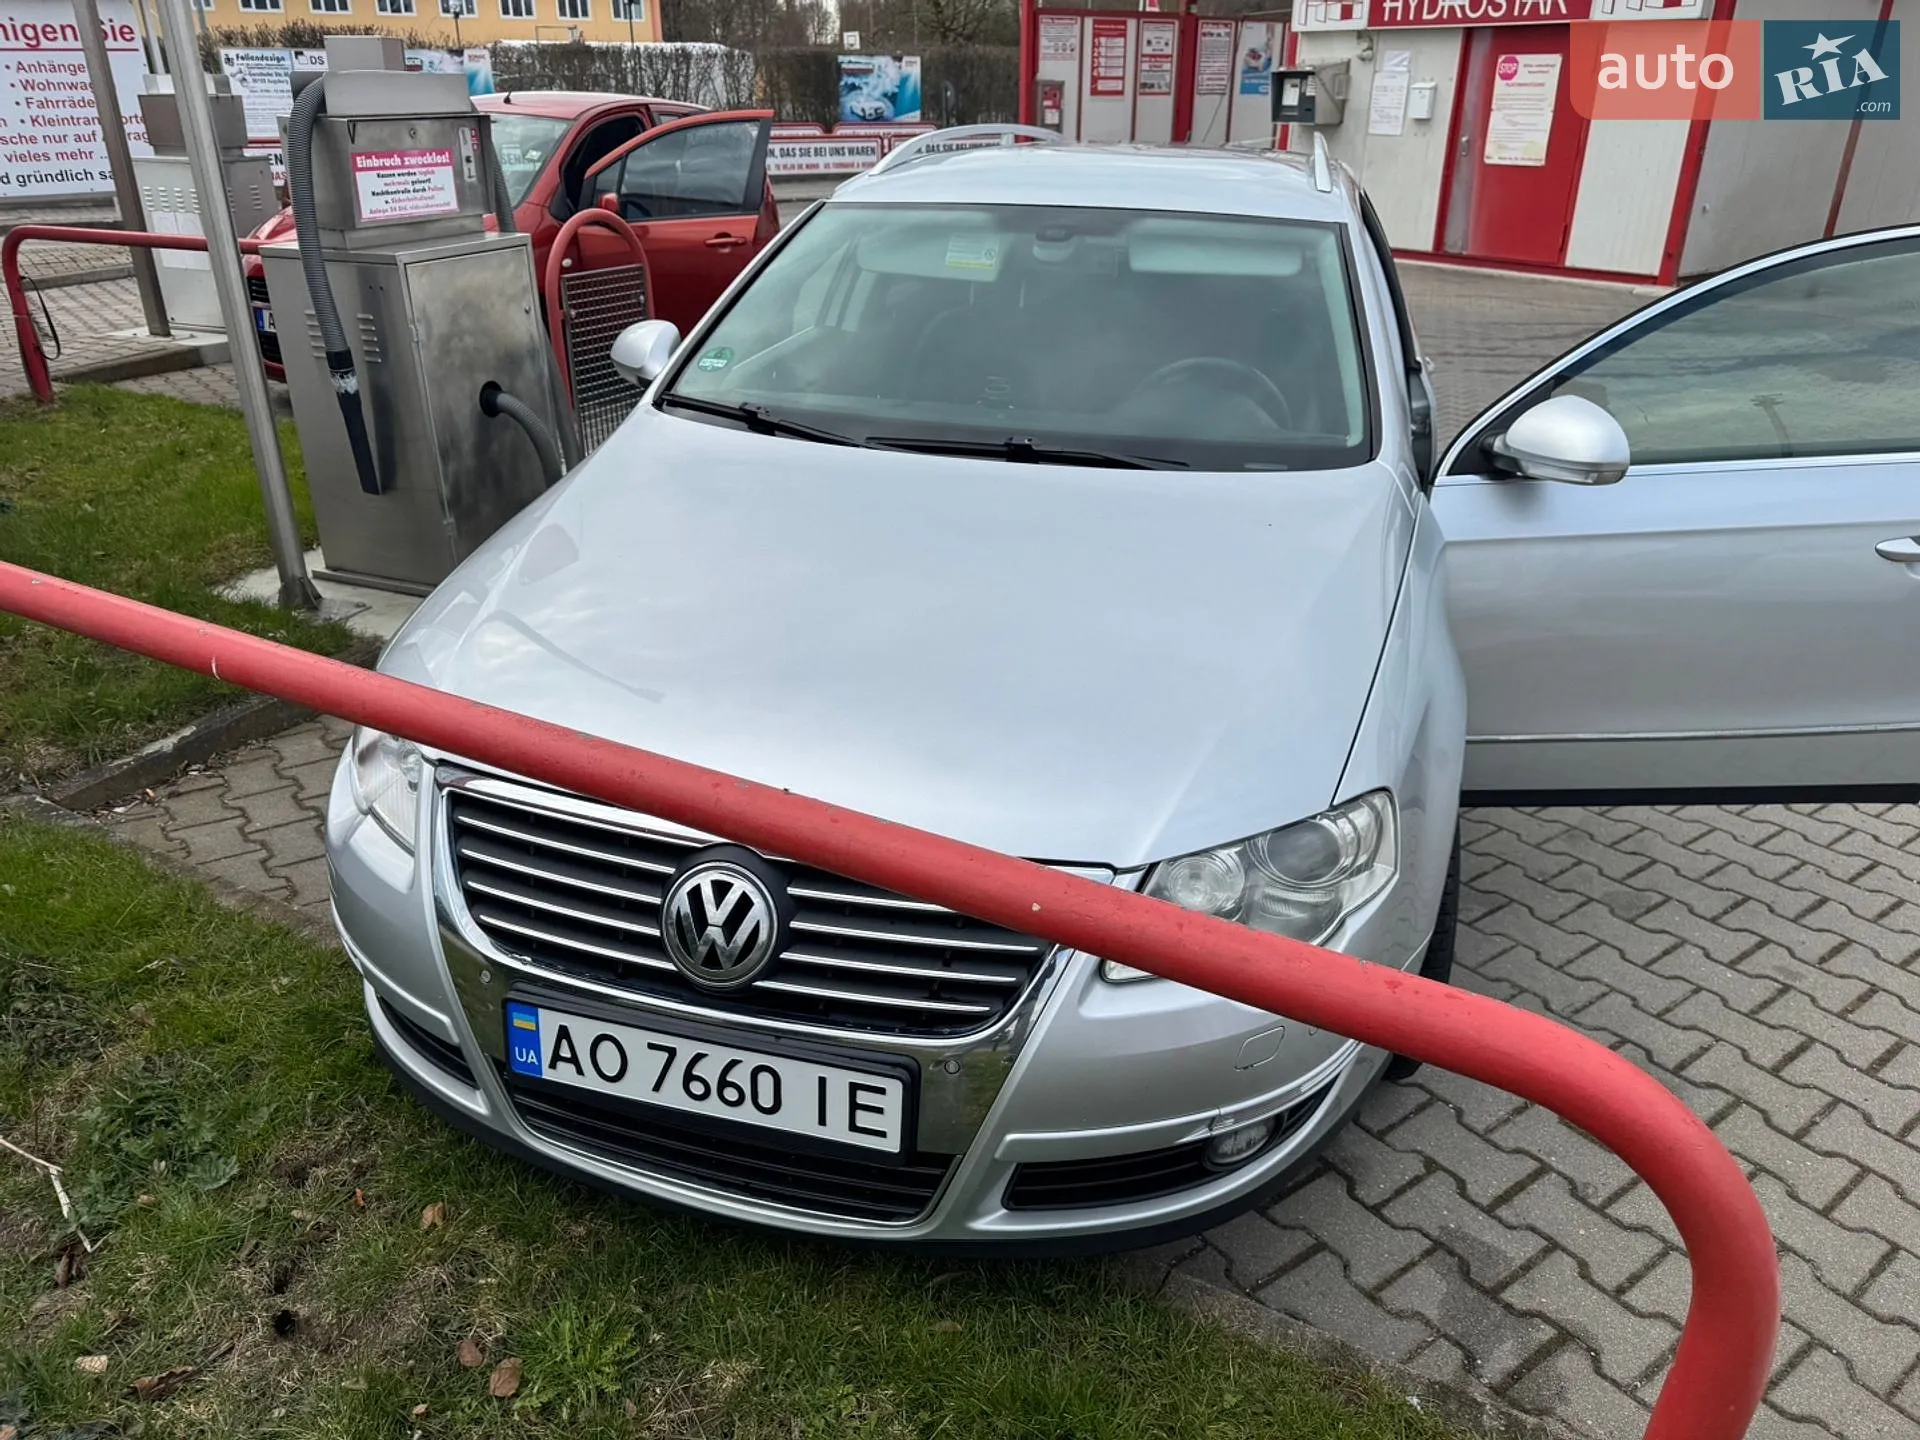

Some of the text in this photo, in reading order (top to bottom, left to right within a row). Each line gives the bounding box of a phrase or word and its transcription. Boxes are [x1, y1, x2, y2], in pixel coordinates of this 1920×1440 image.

[16, 60, 87, 76] Anhänge
[20, 79, 94, 92] Wohnwa
[25, 97, 96, 109] Fahrräde
[42, 133, 68, 144] nur
[74, 130, 97, 142] auf
[4, 150, 51, 163] vieles
[55, 149, 94, 160] mehr
[356, 151, 450, 168] Einbruch zwecklos!
[780, 148, 796, 158] DAS
[799, 147, 811, 158] SIE
[814, 147, 827, 157] BEI
[829, 146, 845, 156] UNS
[16, 168, 94, 187] gründlich
[515, 1046, 538, 1066] UA
[548, 1024, 888, 1139] AO 7660 IE
